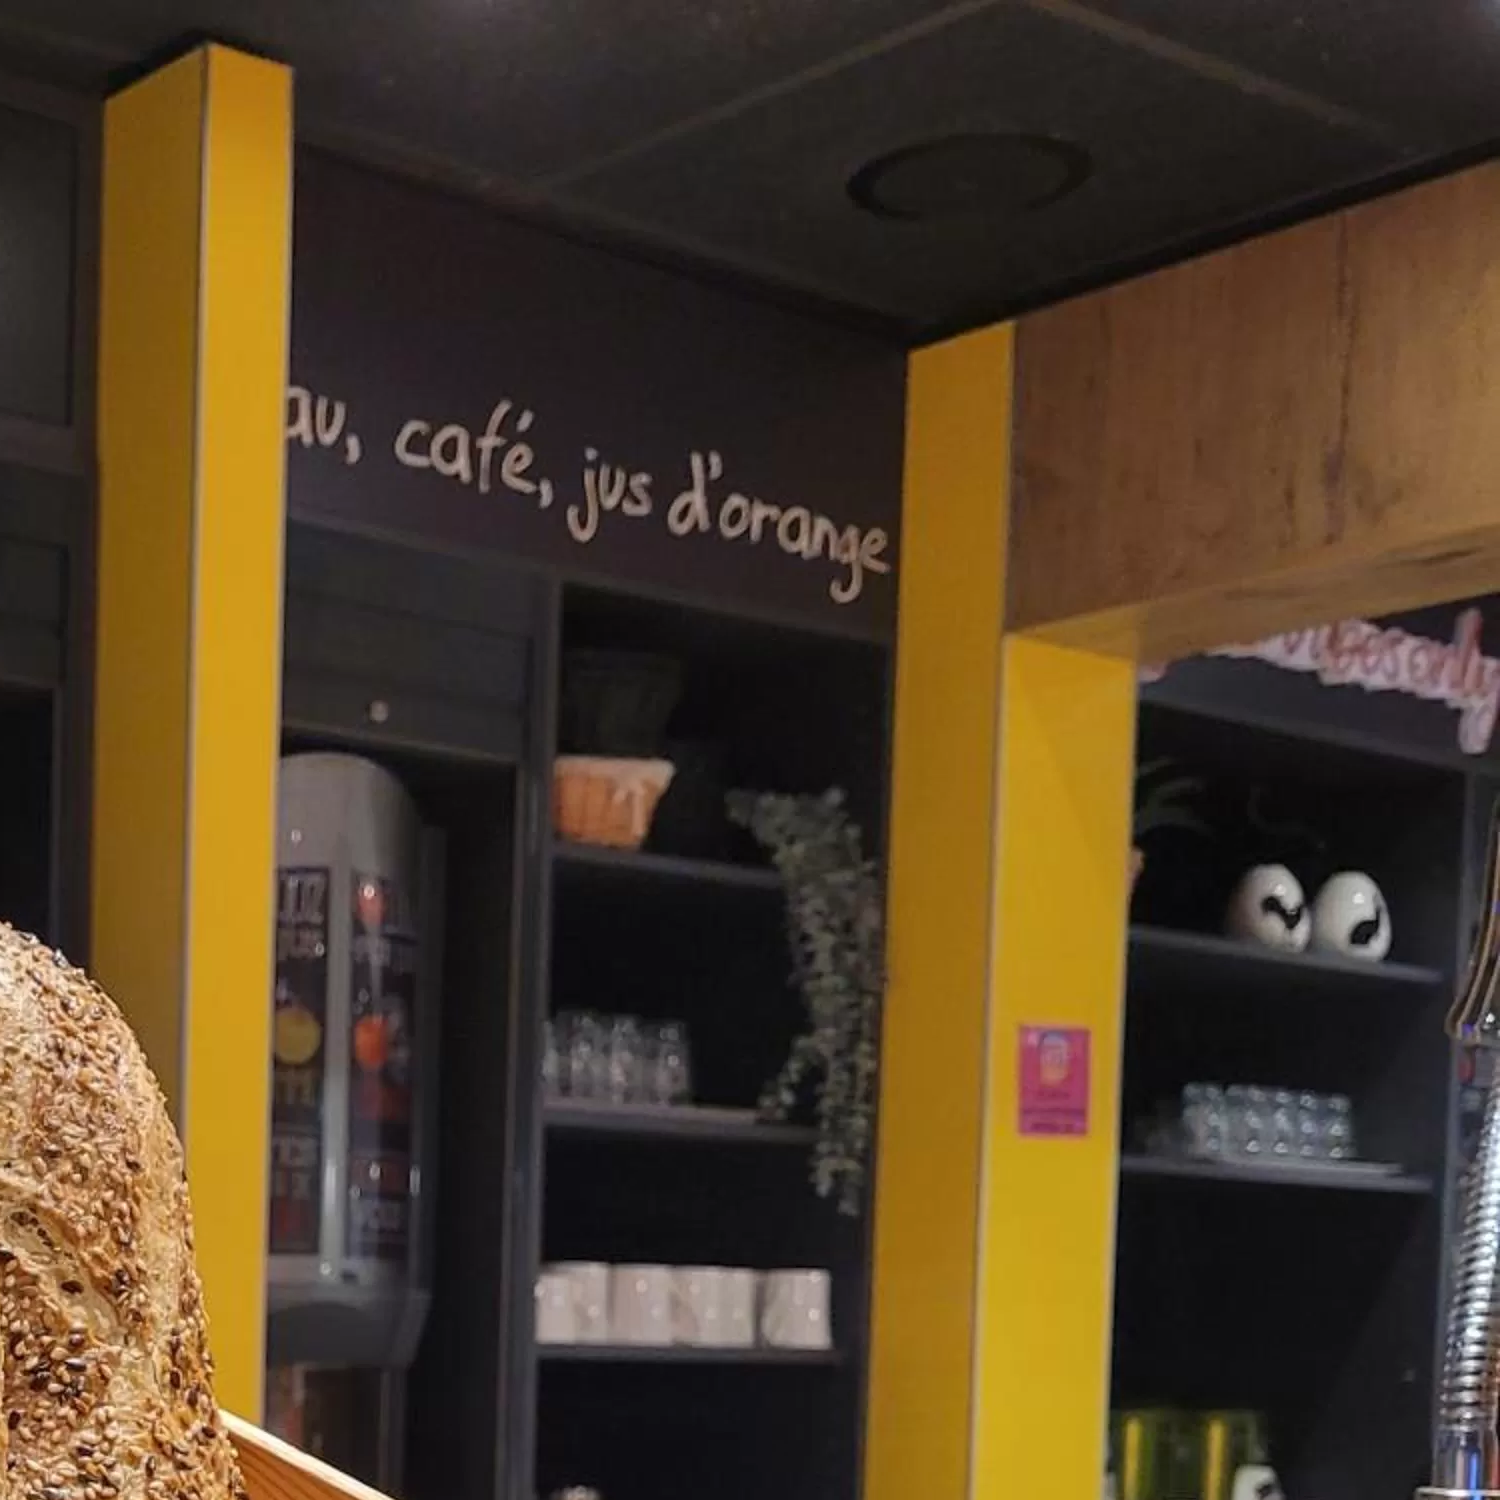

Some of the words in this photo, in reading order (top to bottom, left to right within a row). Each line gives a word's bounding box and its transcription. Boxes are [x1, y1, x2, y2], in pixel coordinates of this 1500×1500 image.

[394, 399, 552, 508] café,
[567, 447, 653, 543] jus
[667, 450, 890, 604] d'orange
